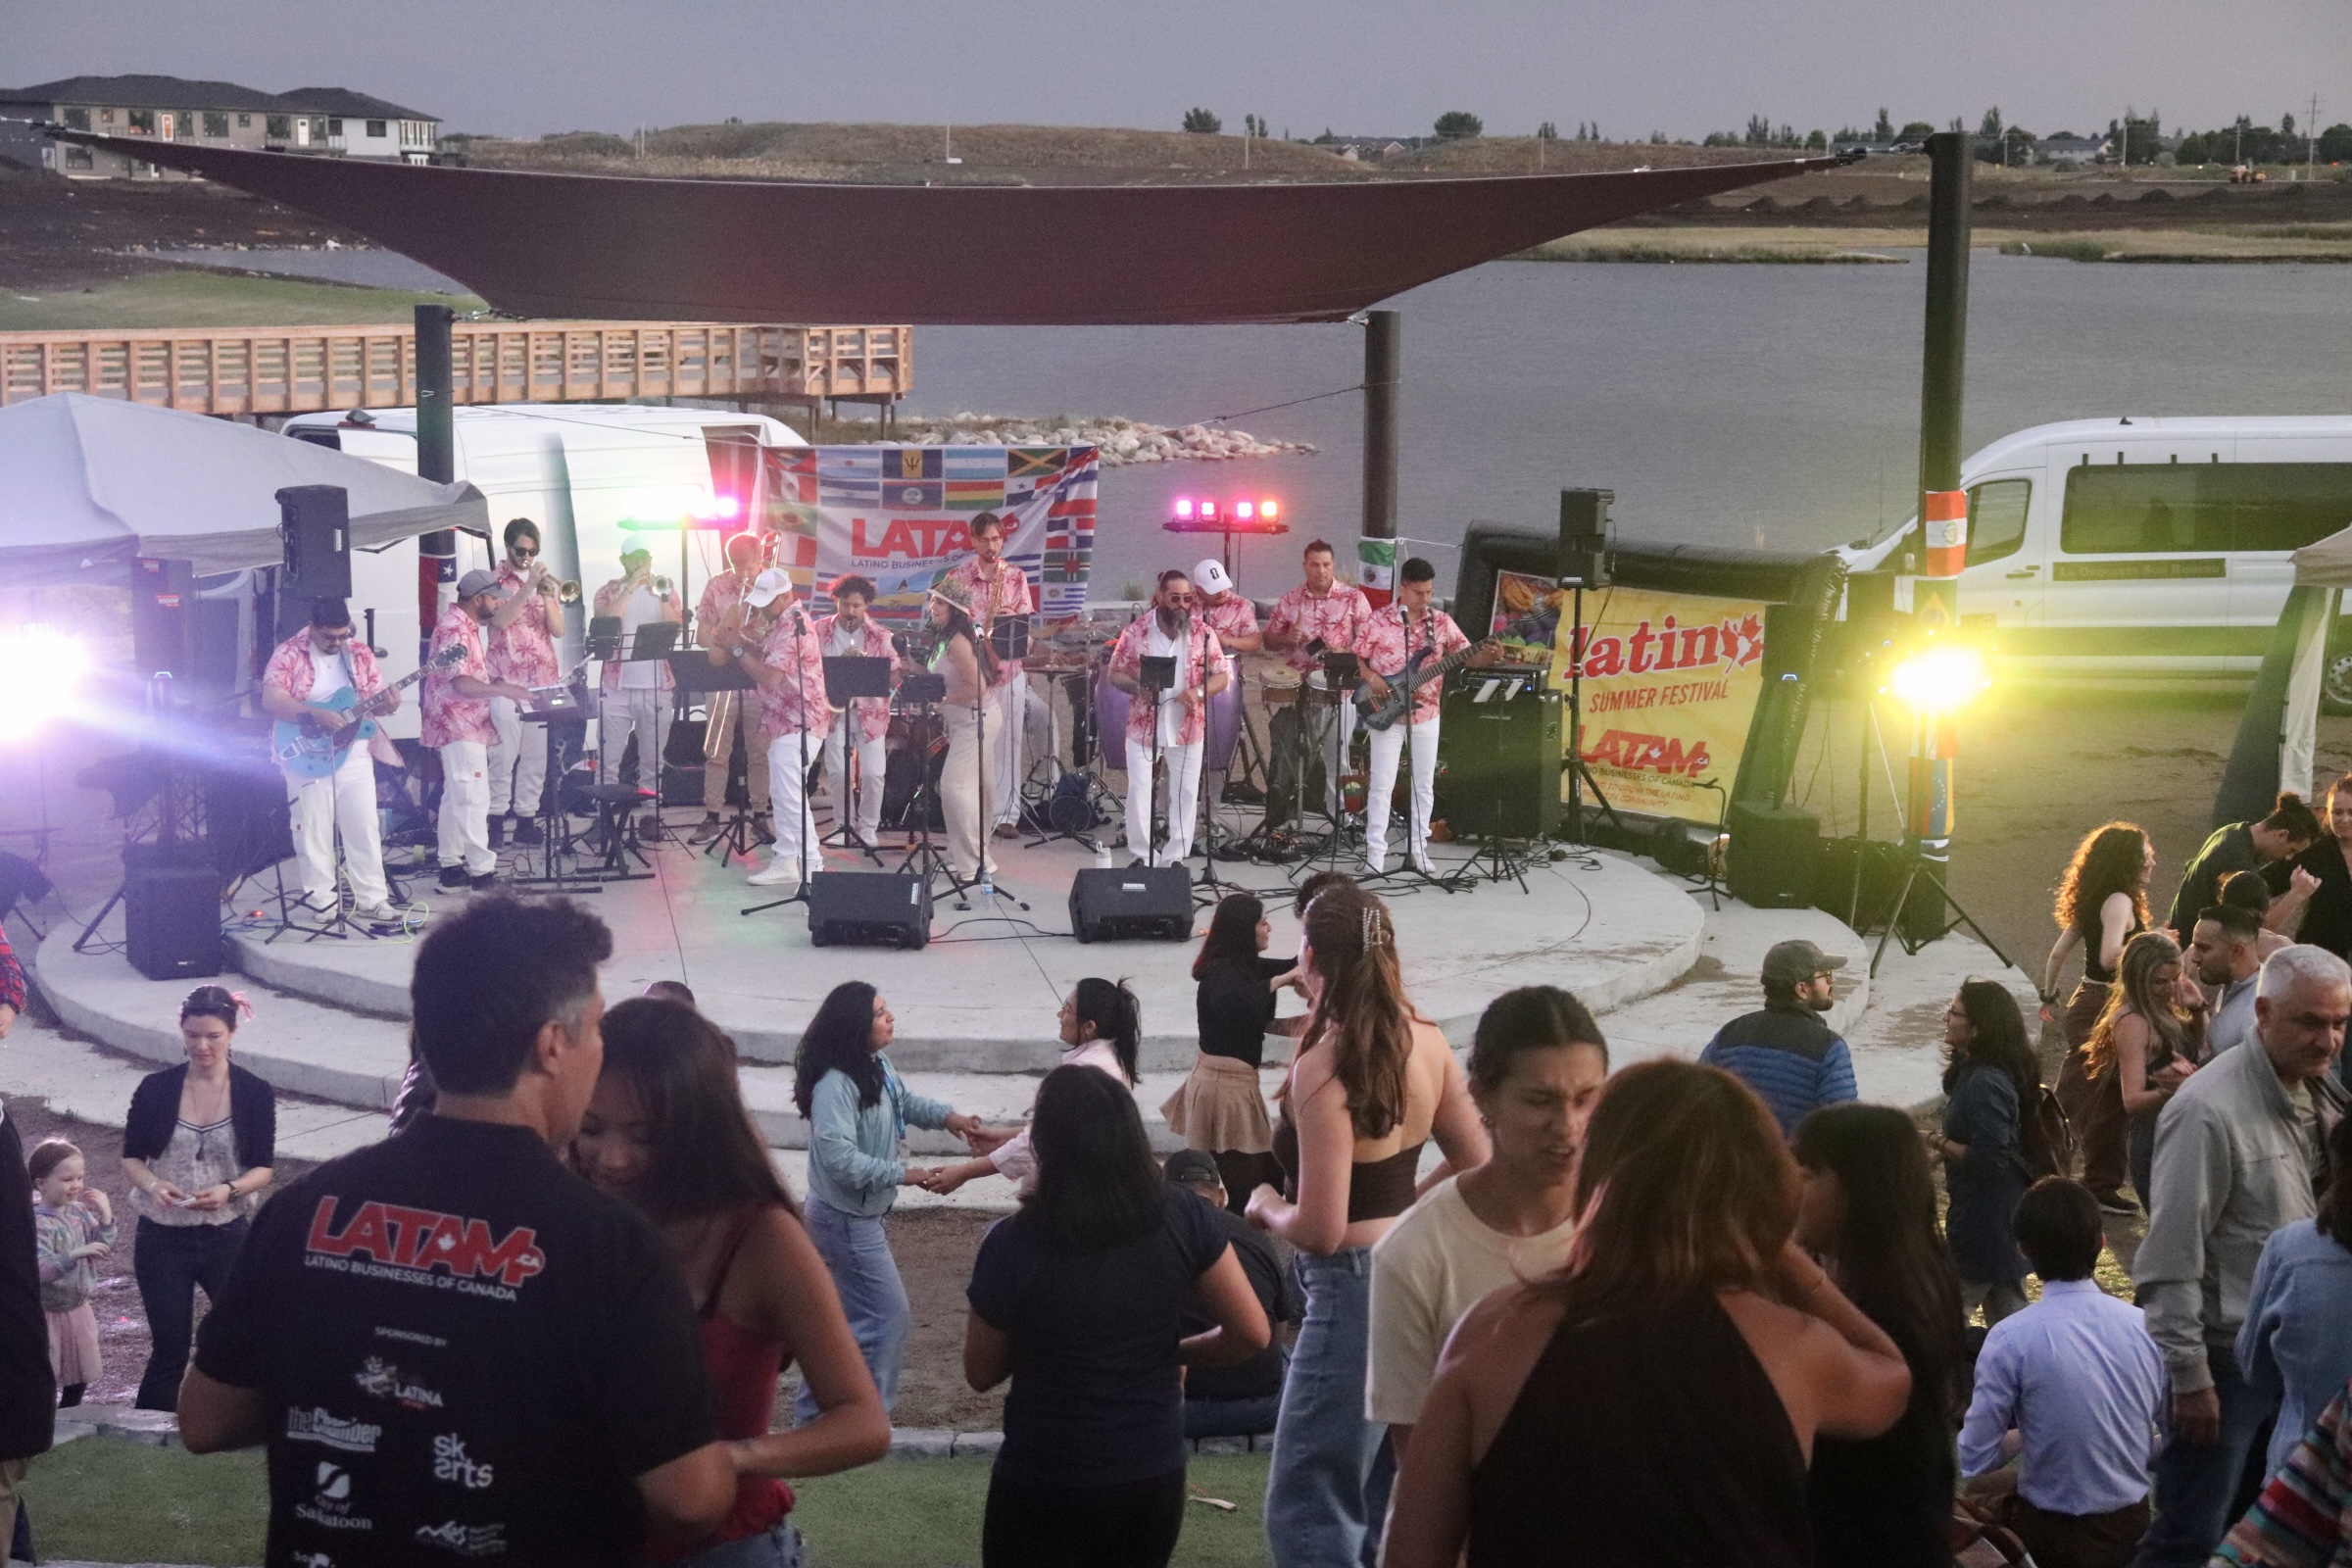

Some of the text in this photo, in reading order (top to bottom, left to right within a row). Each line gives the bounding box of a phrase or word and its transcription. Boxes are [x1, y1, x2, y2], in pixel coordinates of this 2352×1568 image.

[852, 514, 1011, 559] LATA
[851, 560, 889, 568] LATINO
[1589, 679, 1729, 713] SUMMER FESTIVAL
[1599, 767, 1646, 782] BUSINESSES
[1661, 776, 1695, 789] CANADA
[1618, 784, 1644, 794] GROW
[1645, 788, 1658, 798] THE
[1660, 790, 1690, 802] LATINO
[306, 1195, 536, 1288] LATAM
[304, 1254, 517, 1302] LATINO BUSINESSES OF CANADA
[394, 1382, 444, 1407] LATINA
[433, 1433, 466, 1458] sk
